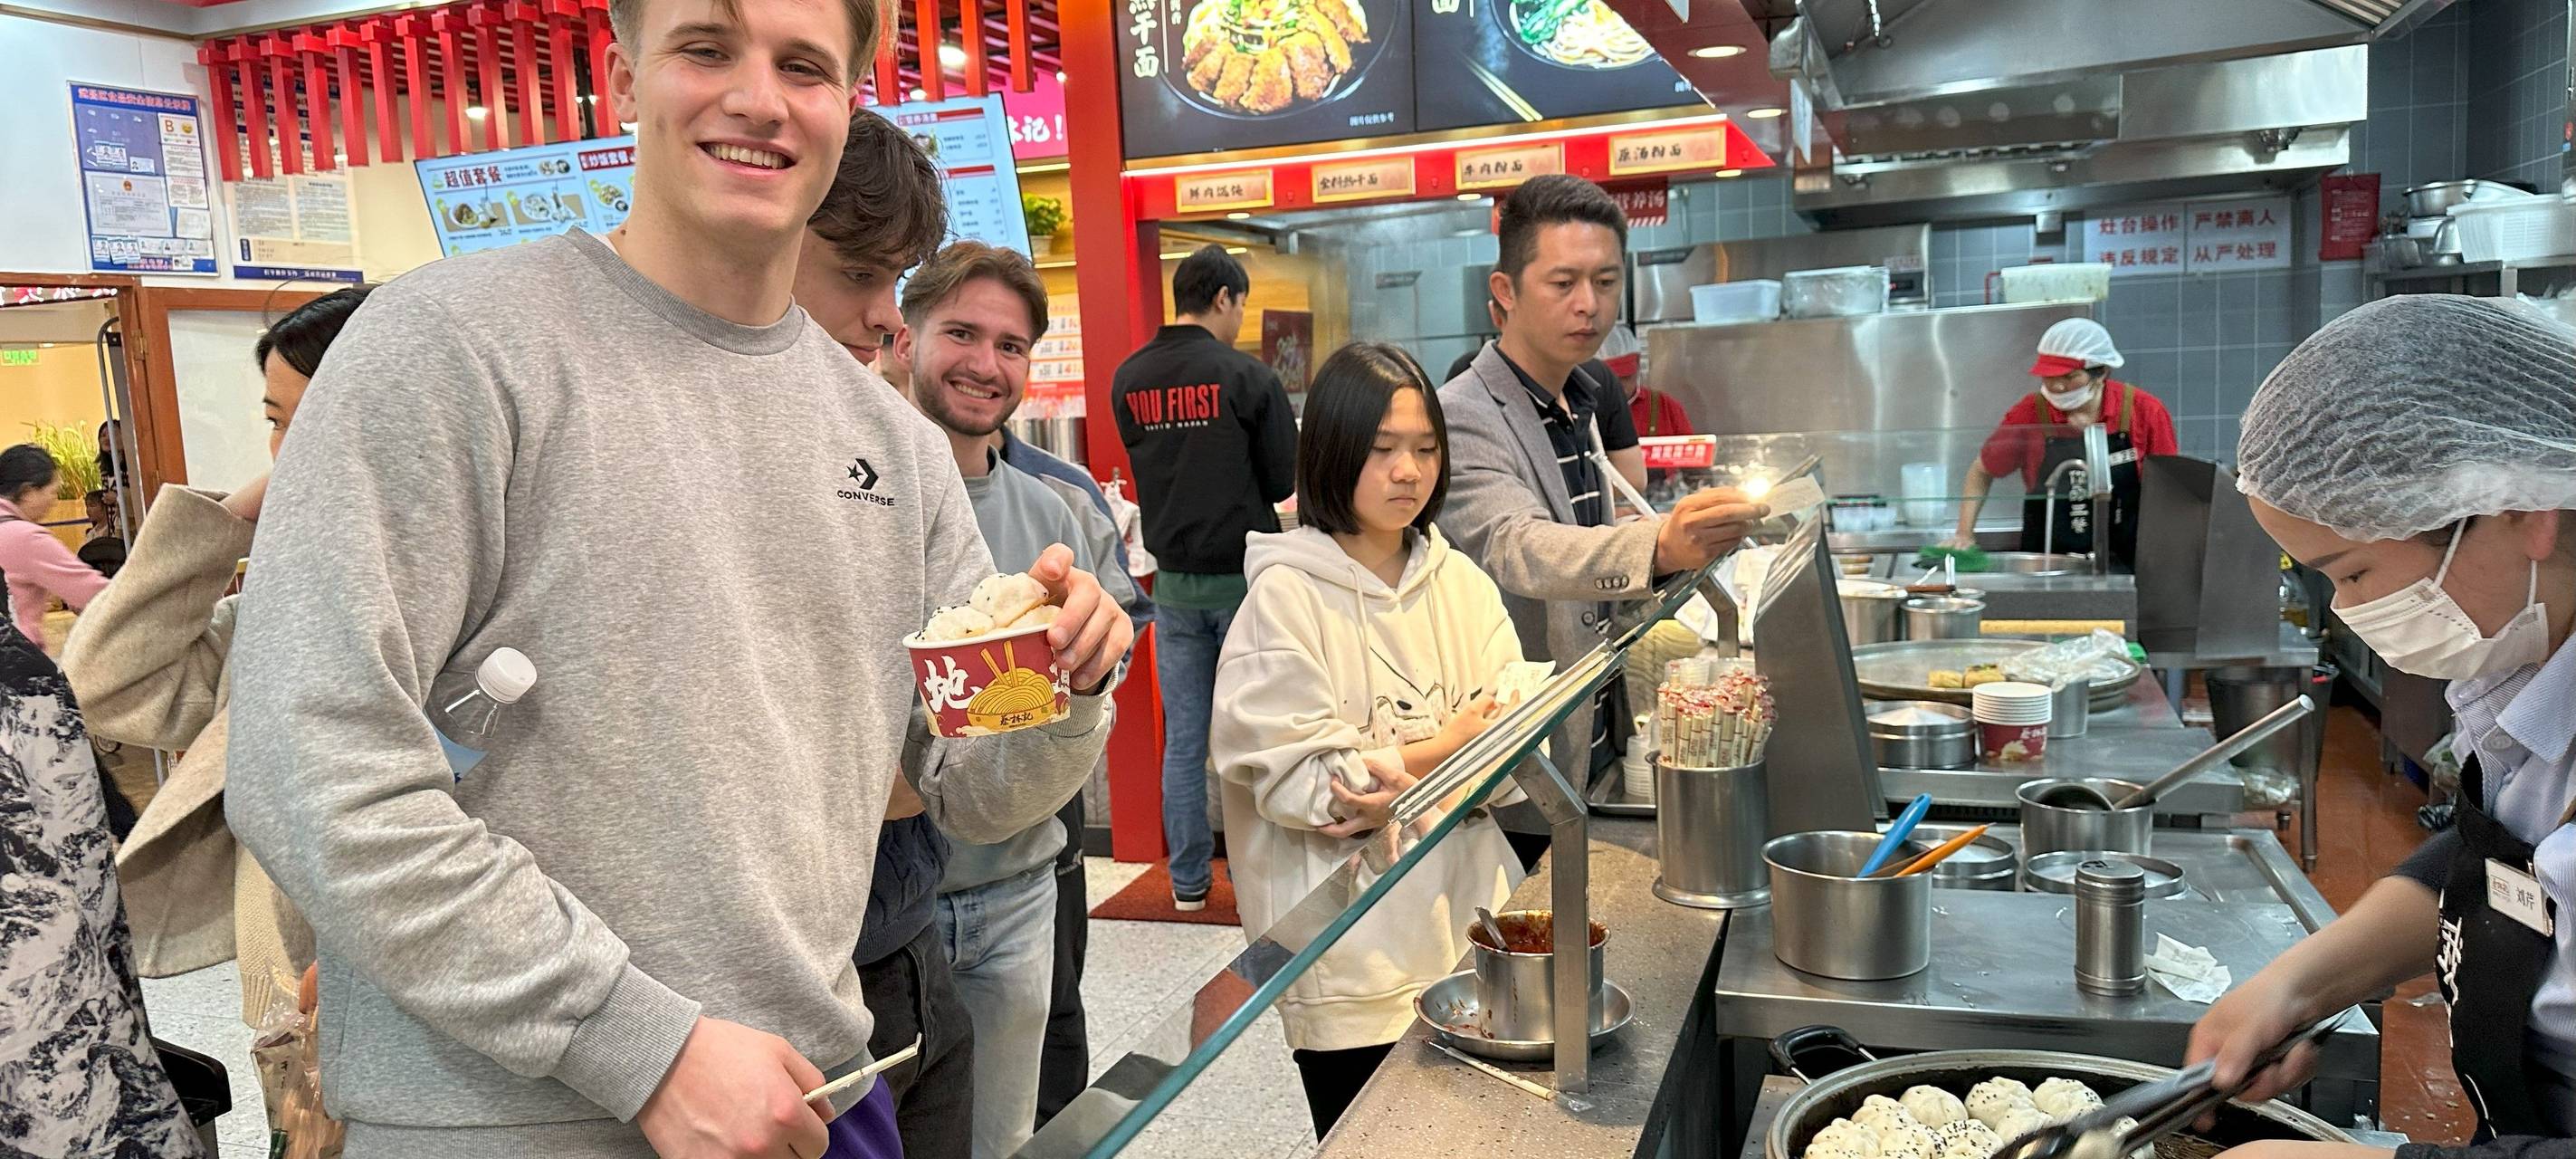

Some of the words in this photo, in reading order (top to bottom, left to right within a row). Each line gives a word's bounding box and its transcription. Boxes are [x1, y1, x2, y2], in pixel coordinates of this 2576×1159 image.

[166, 120, 175, 132] B
[1617, 143, 1682, 162] 原汤粉面
[444, 165, 502, 188] 超值套餐
[1463, 160, 1523, 176] 牛肉粉面
[2098, 213, 2179, 235] 灶台操作
[2194, 208, 2276, 231] 严禁离人
[2099, 246, 2179, 267] 违反规定
[2193, 241, 2277, 263] 从严处理
[1126, 389, 1162, 425] YOU
[1168, 383, 1220, 420] FIRST
[836, 489, 895, 507] CONVERSE
[924, 656, 984, 713] 地
